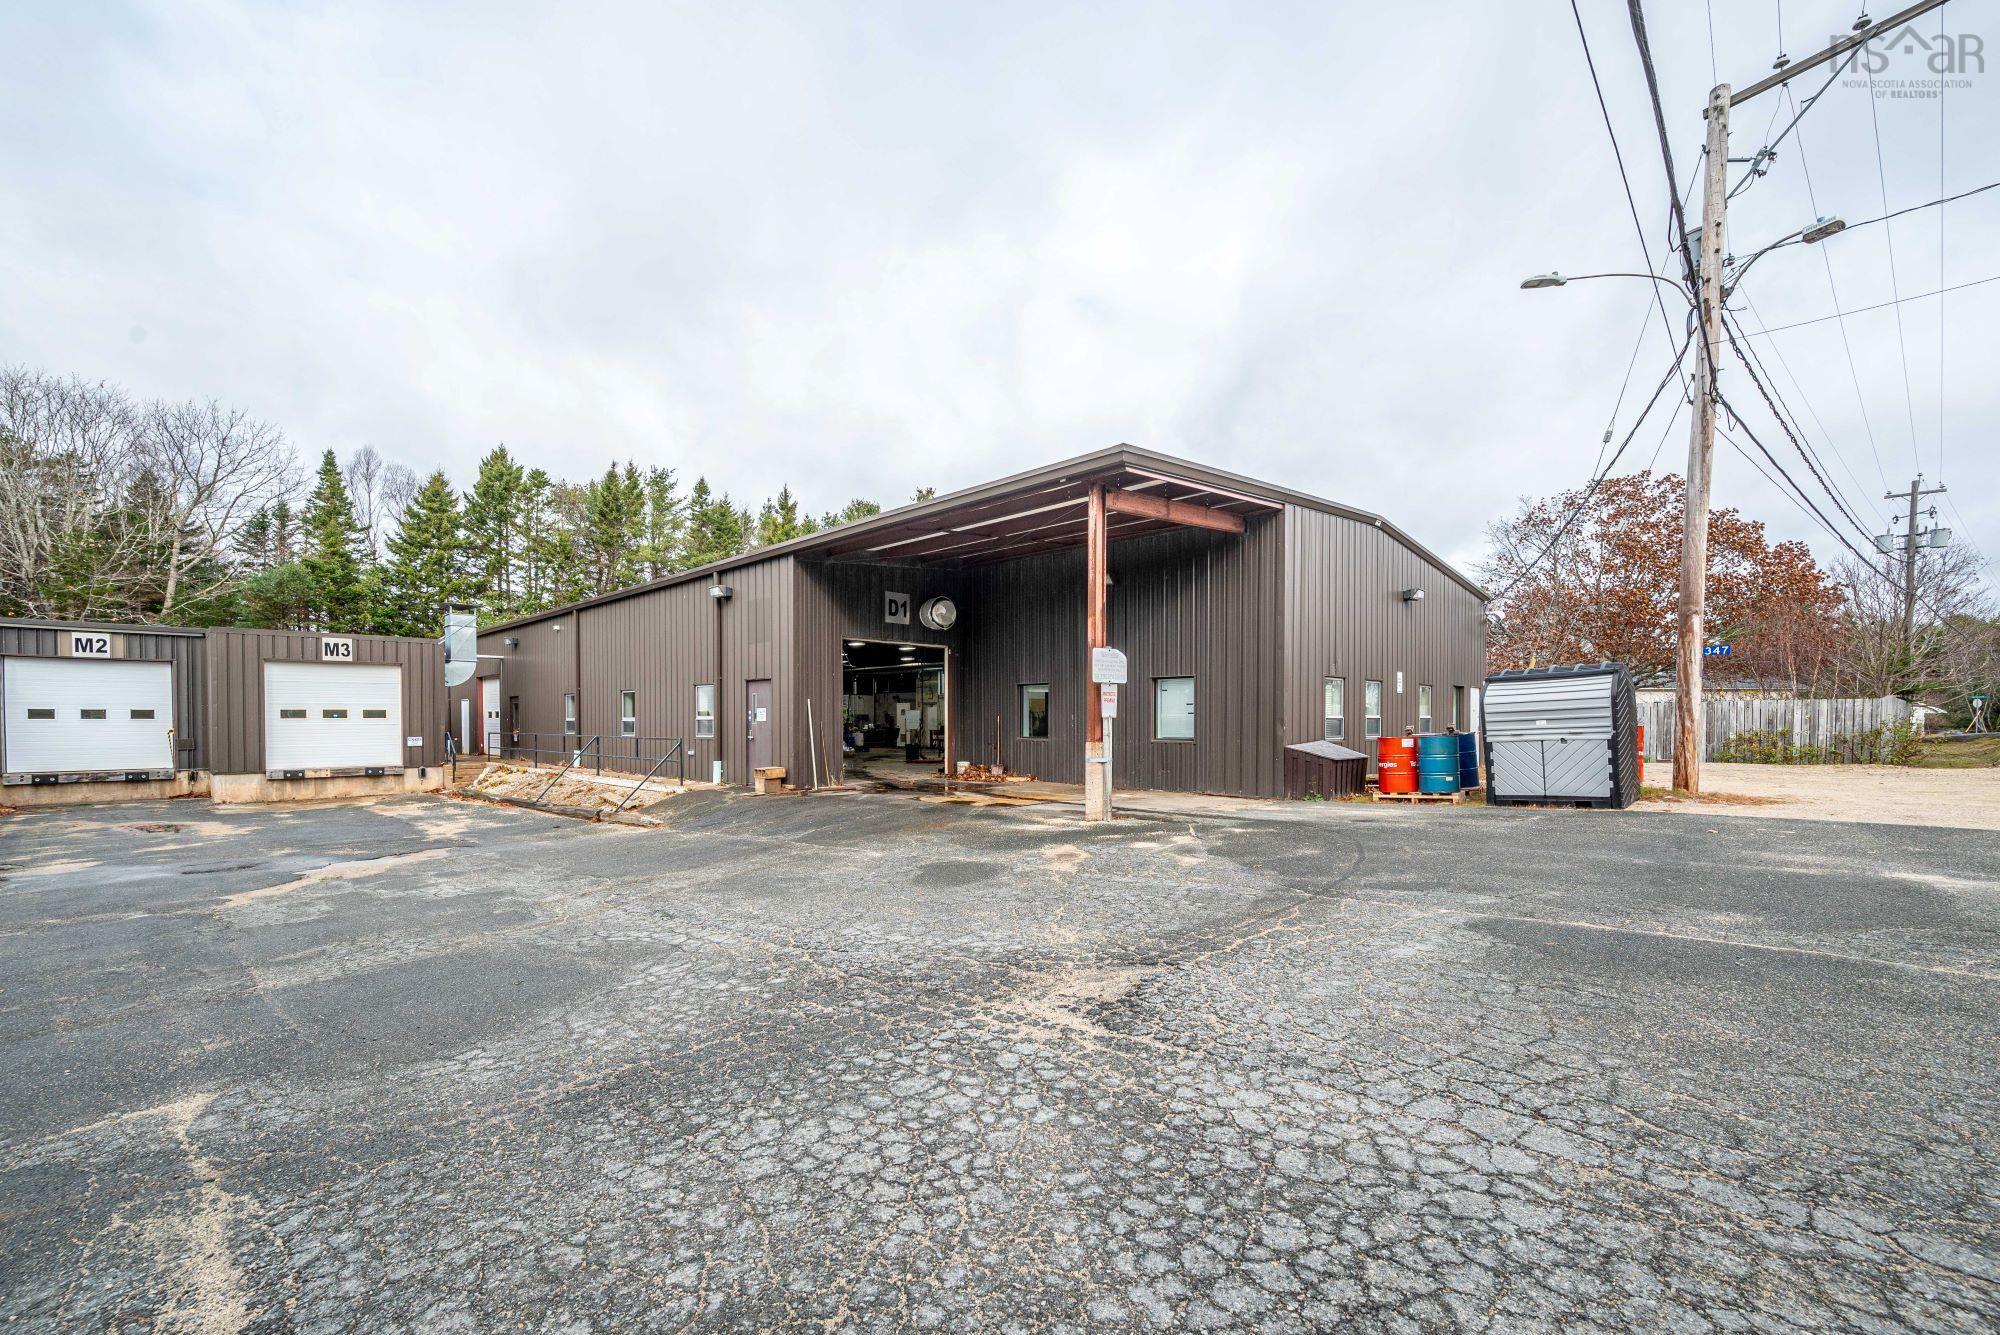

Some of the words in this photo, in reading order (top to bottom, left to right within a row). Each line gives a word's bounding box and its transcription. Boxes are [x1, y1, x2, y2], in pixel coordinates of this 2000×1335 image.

[889, 599, 907, 618] D1
[74, 637, 108, 654] M2
[324, 642, 351, 657] M3
[1704, 646, 1728, 655] 347
